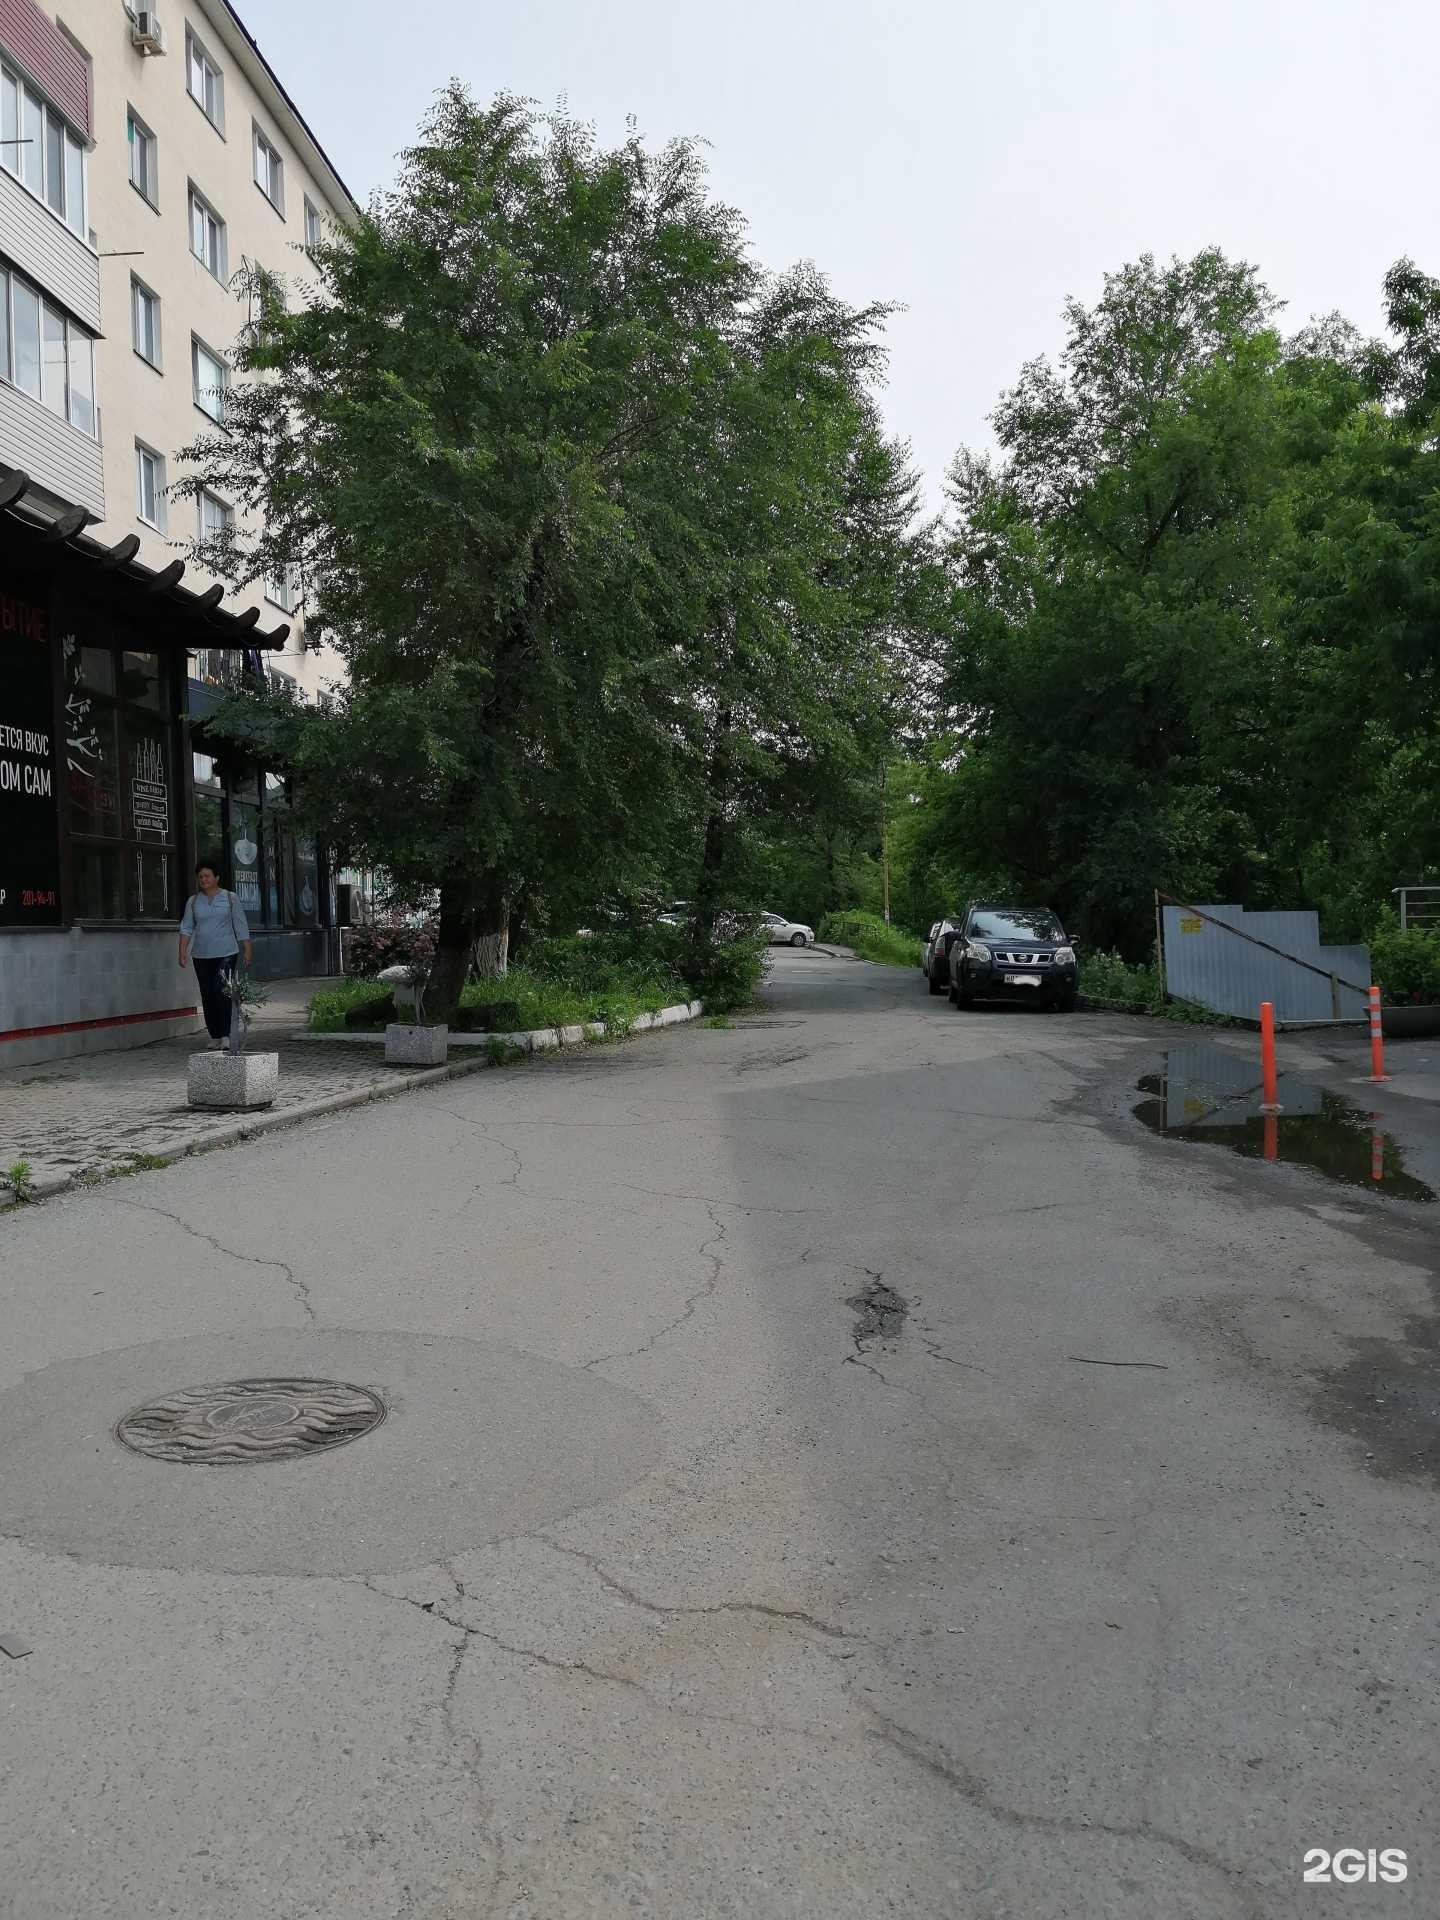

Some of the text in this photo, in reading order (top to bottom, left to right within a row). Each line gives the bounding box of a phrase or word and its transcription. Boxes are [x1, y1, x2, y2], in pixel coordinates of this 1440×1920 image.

[0, 598, 47, 643] ЫТИЕ
[0, 724, 49, 756] ЕТСЯ ВКУС
[0, 760, 21, 792] ОМ
[24, 765, 52, 797] САМ
